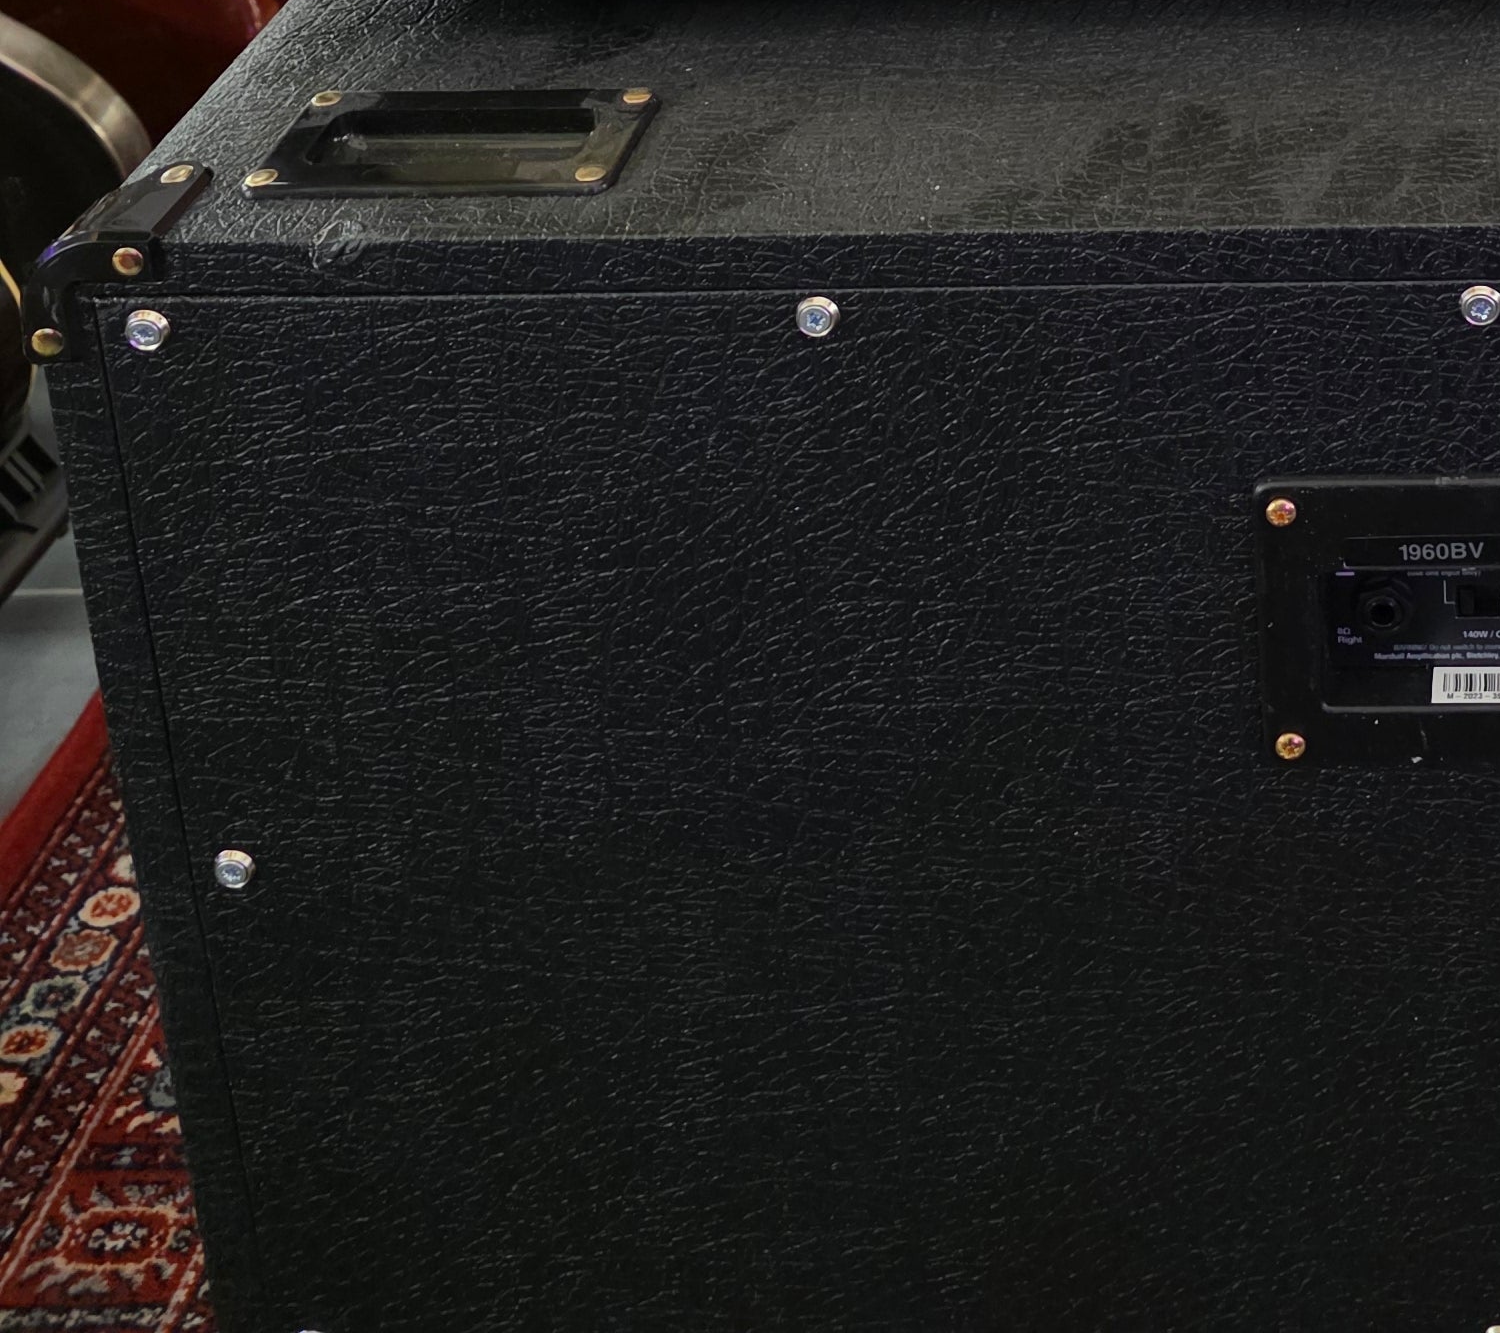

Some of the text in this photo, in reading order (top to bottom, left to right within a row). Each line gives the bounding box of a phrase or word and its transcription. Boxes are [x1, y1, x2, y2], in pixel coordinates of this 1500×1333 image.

[1398, 542, 1485, 561] 1960BV
[1463, 630, 1488, 639] 140W
[1337, 635, 1363, 646] Right
